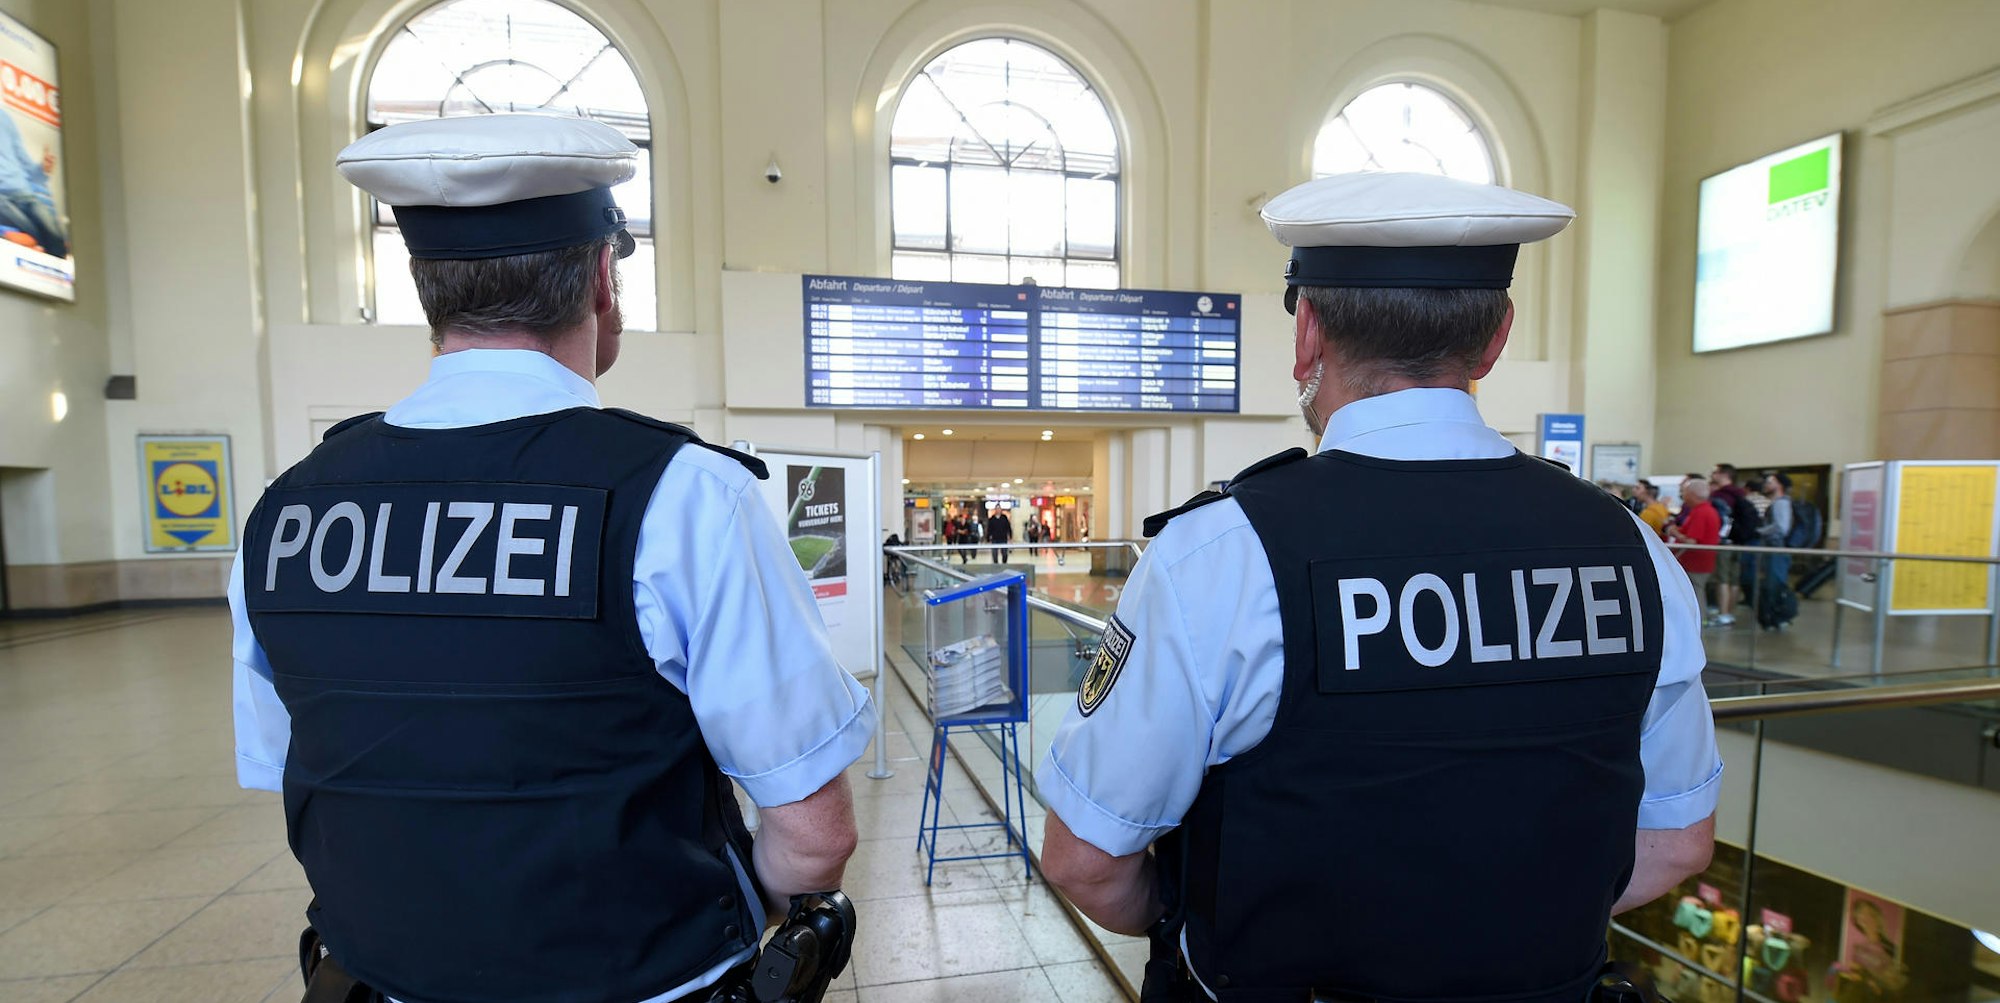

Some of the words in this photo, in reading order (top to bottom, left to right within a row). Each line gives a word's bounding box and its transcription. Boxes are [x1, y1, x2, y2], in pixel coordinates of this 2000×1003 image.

[1766, 192, 1829, 222] DATEV
[809, 278, 847, 291] Abfahrt
[852, 282, 891, 294] Departure
[897, 284, 924, 295] Départ
[1040, 289, 1074, 300] Abfahrt
[1079, 292, 1114, 303] Departure
[800, 483, 813, 497] 96
[805, 502, 839, 518] TICKETS
[265, 501, 579, 597] POLIZEI
[1337, 565, 1645, 671] POLIZEI
